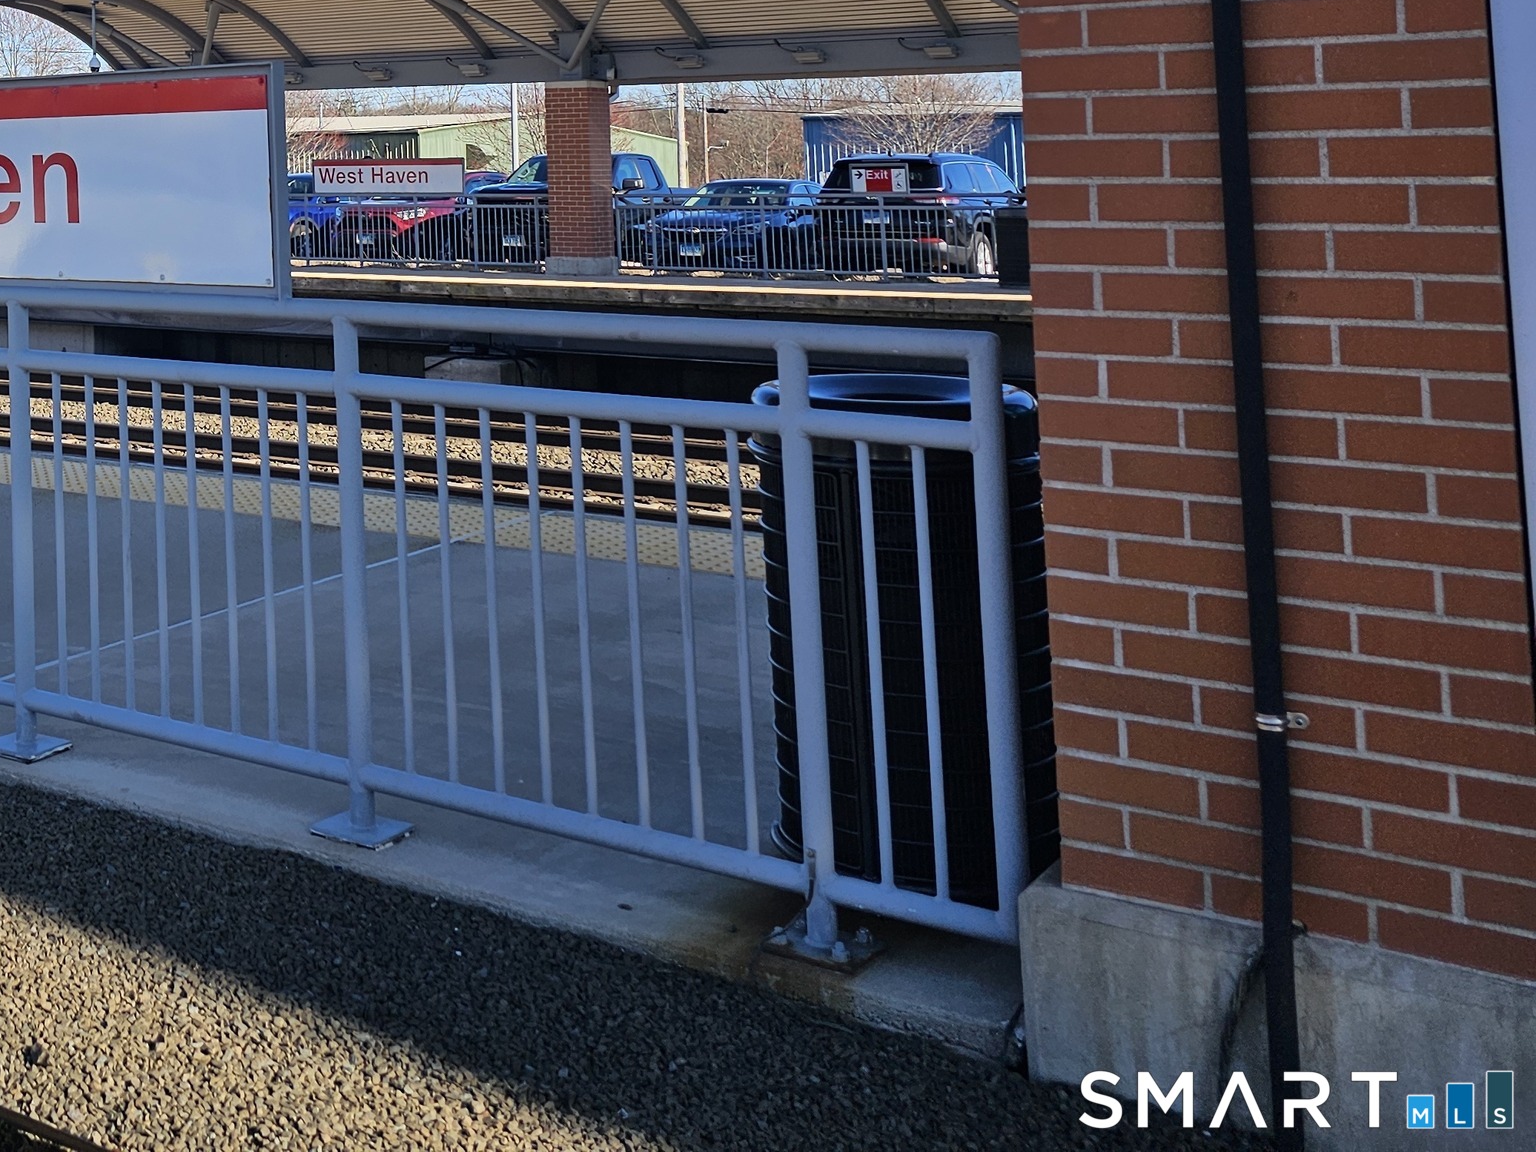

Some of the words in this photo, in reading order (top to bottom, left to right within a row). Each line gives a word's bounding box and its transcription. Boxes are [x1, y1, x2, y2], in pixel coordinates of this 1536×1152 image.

[319, 167, 364, 184] West
[371, 167, 429, 184] Haven
[866, 169, 889, 180] Exit
